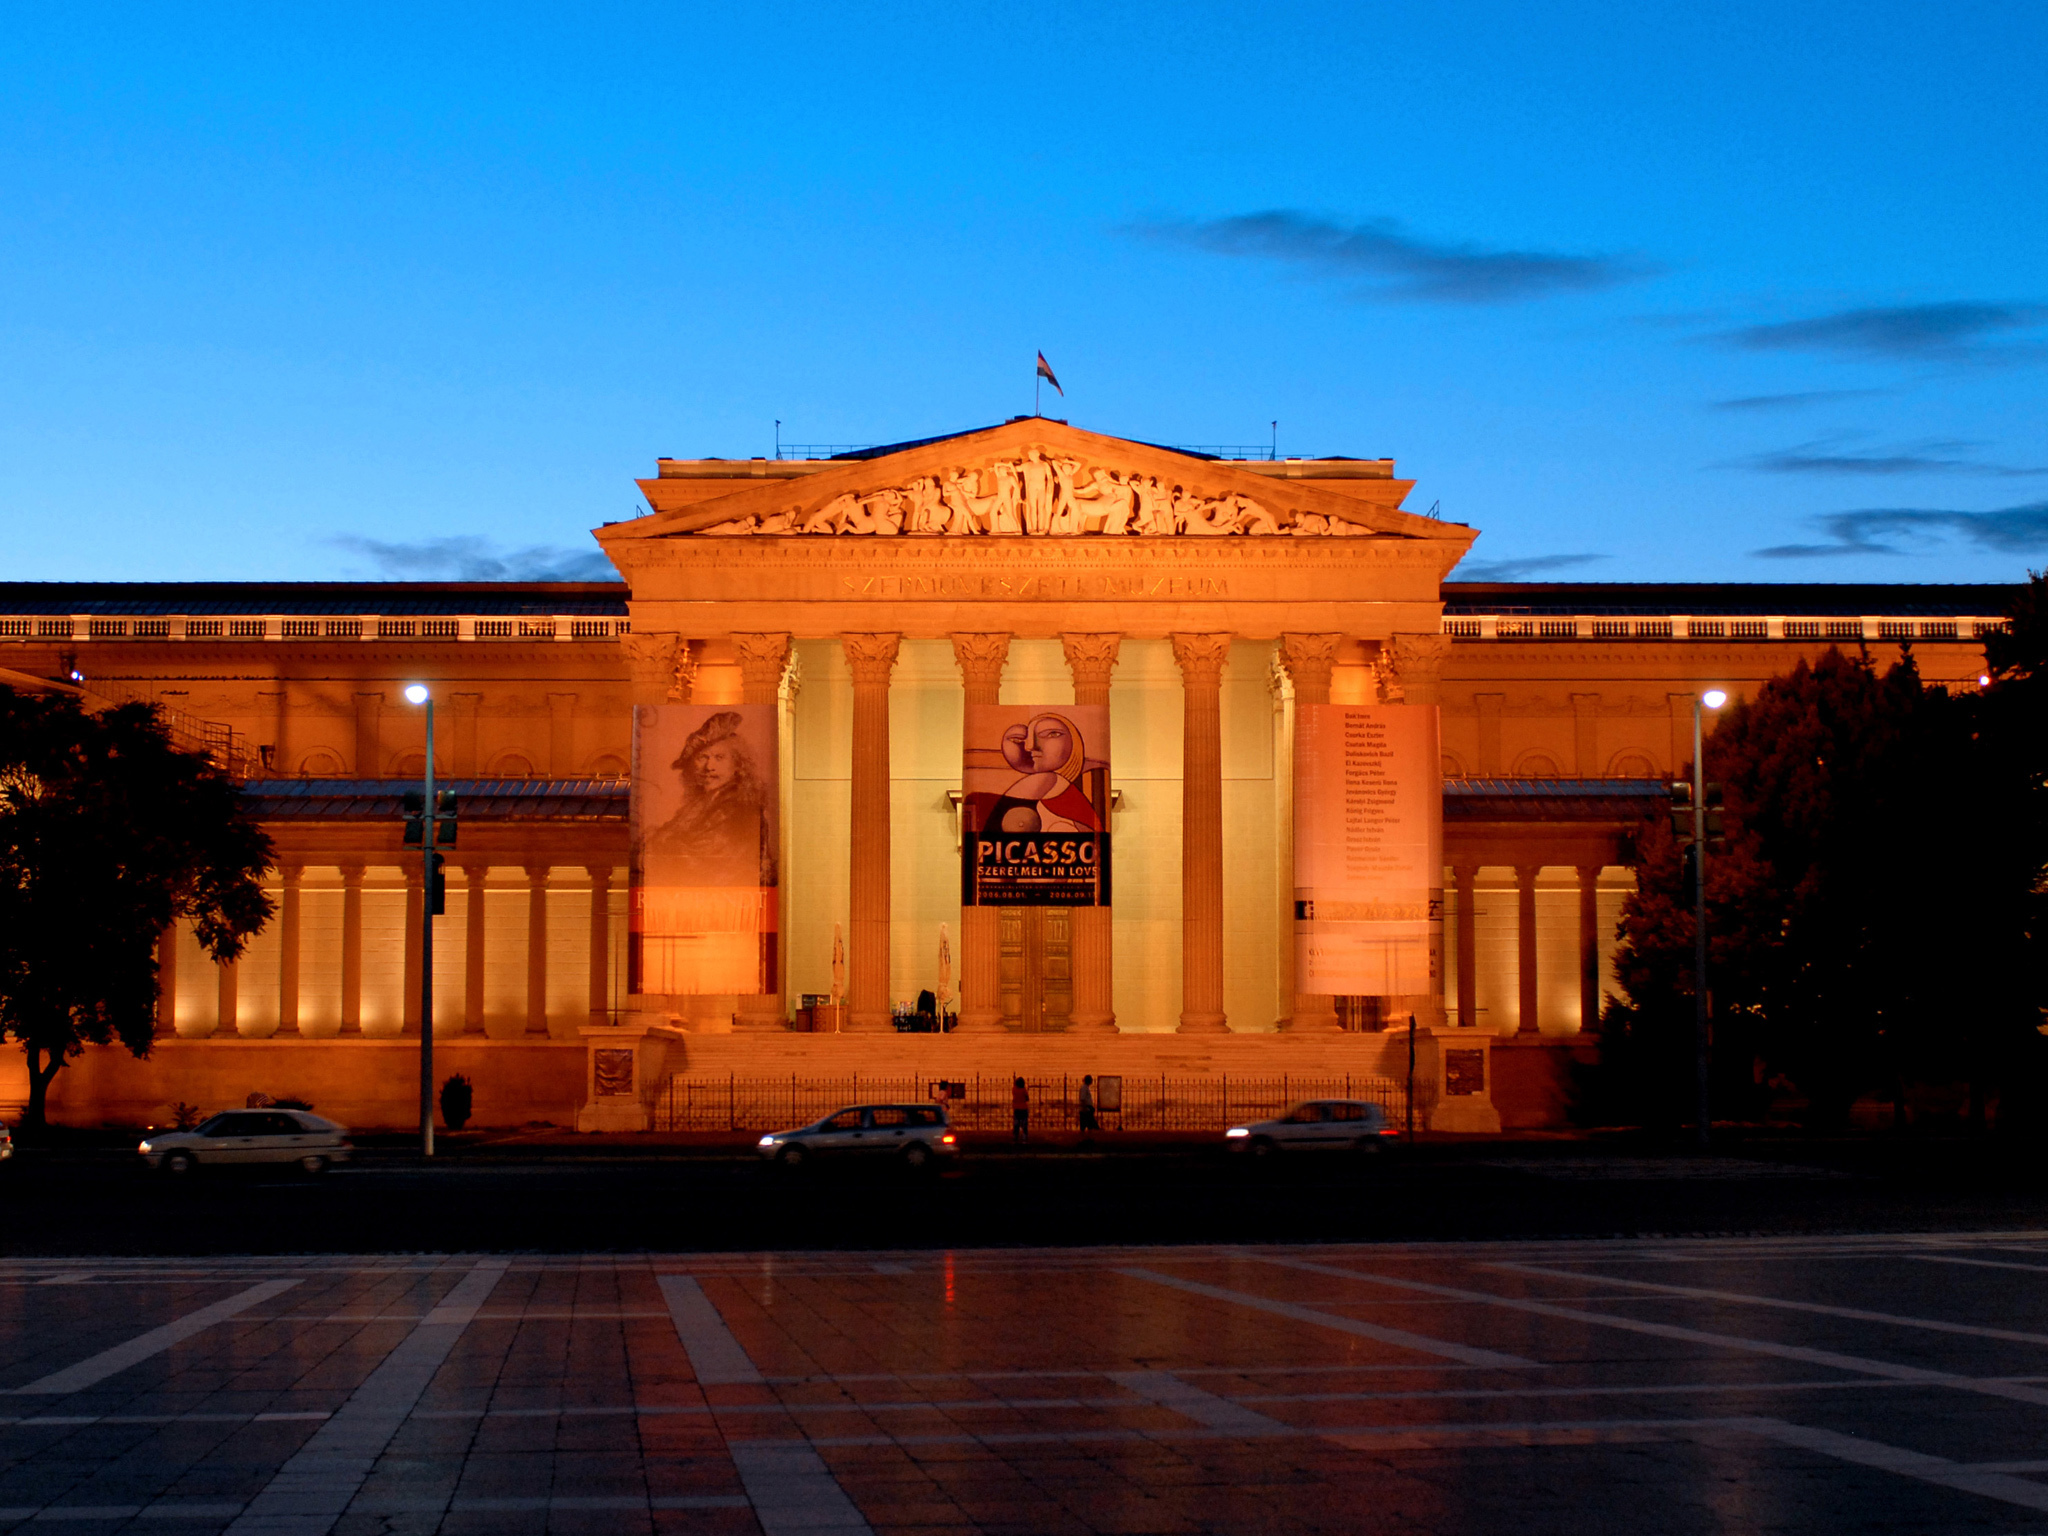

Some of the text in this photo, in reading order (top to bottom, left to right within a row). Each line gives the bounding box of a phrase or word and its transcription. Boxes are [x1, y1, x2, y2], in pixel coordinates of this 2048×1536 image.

[978, 841, 1096, 864] PICASSO
[978, 866, 1042, 876] SZERELMEI
[1053, 866, 1064, 876] IN
